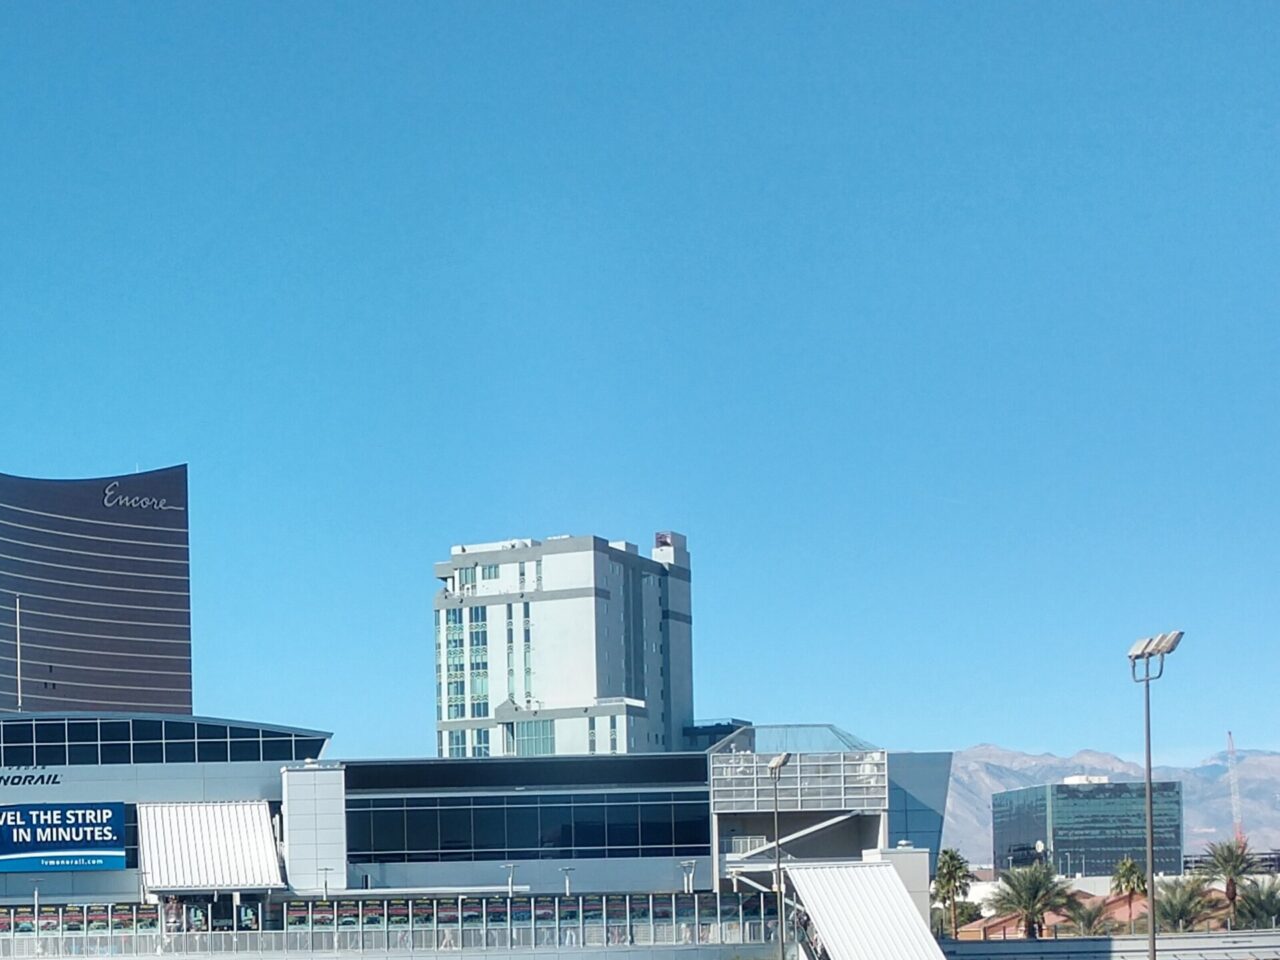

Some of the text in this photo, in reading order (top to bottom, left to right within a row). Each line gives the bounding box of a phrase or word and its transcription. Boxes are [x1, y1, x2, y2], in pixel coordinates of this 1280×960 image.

[103, 481, 184, 510] Encore
[29, 810, 63, 825] THE
[66, 808, 113, 824] STRIP
[12, 826, 118, 843] IN MINUTES.
